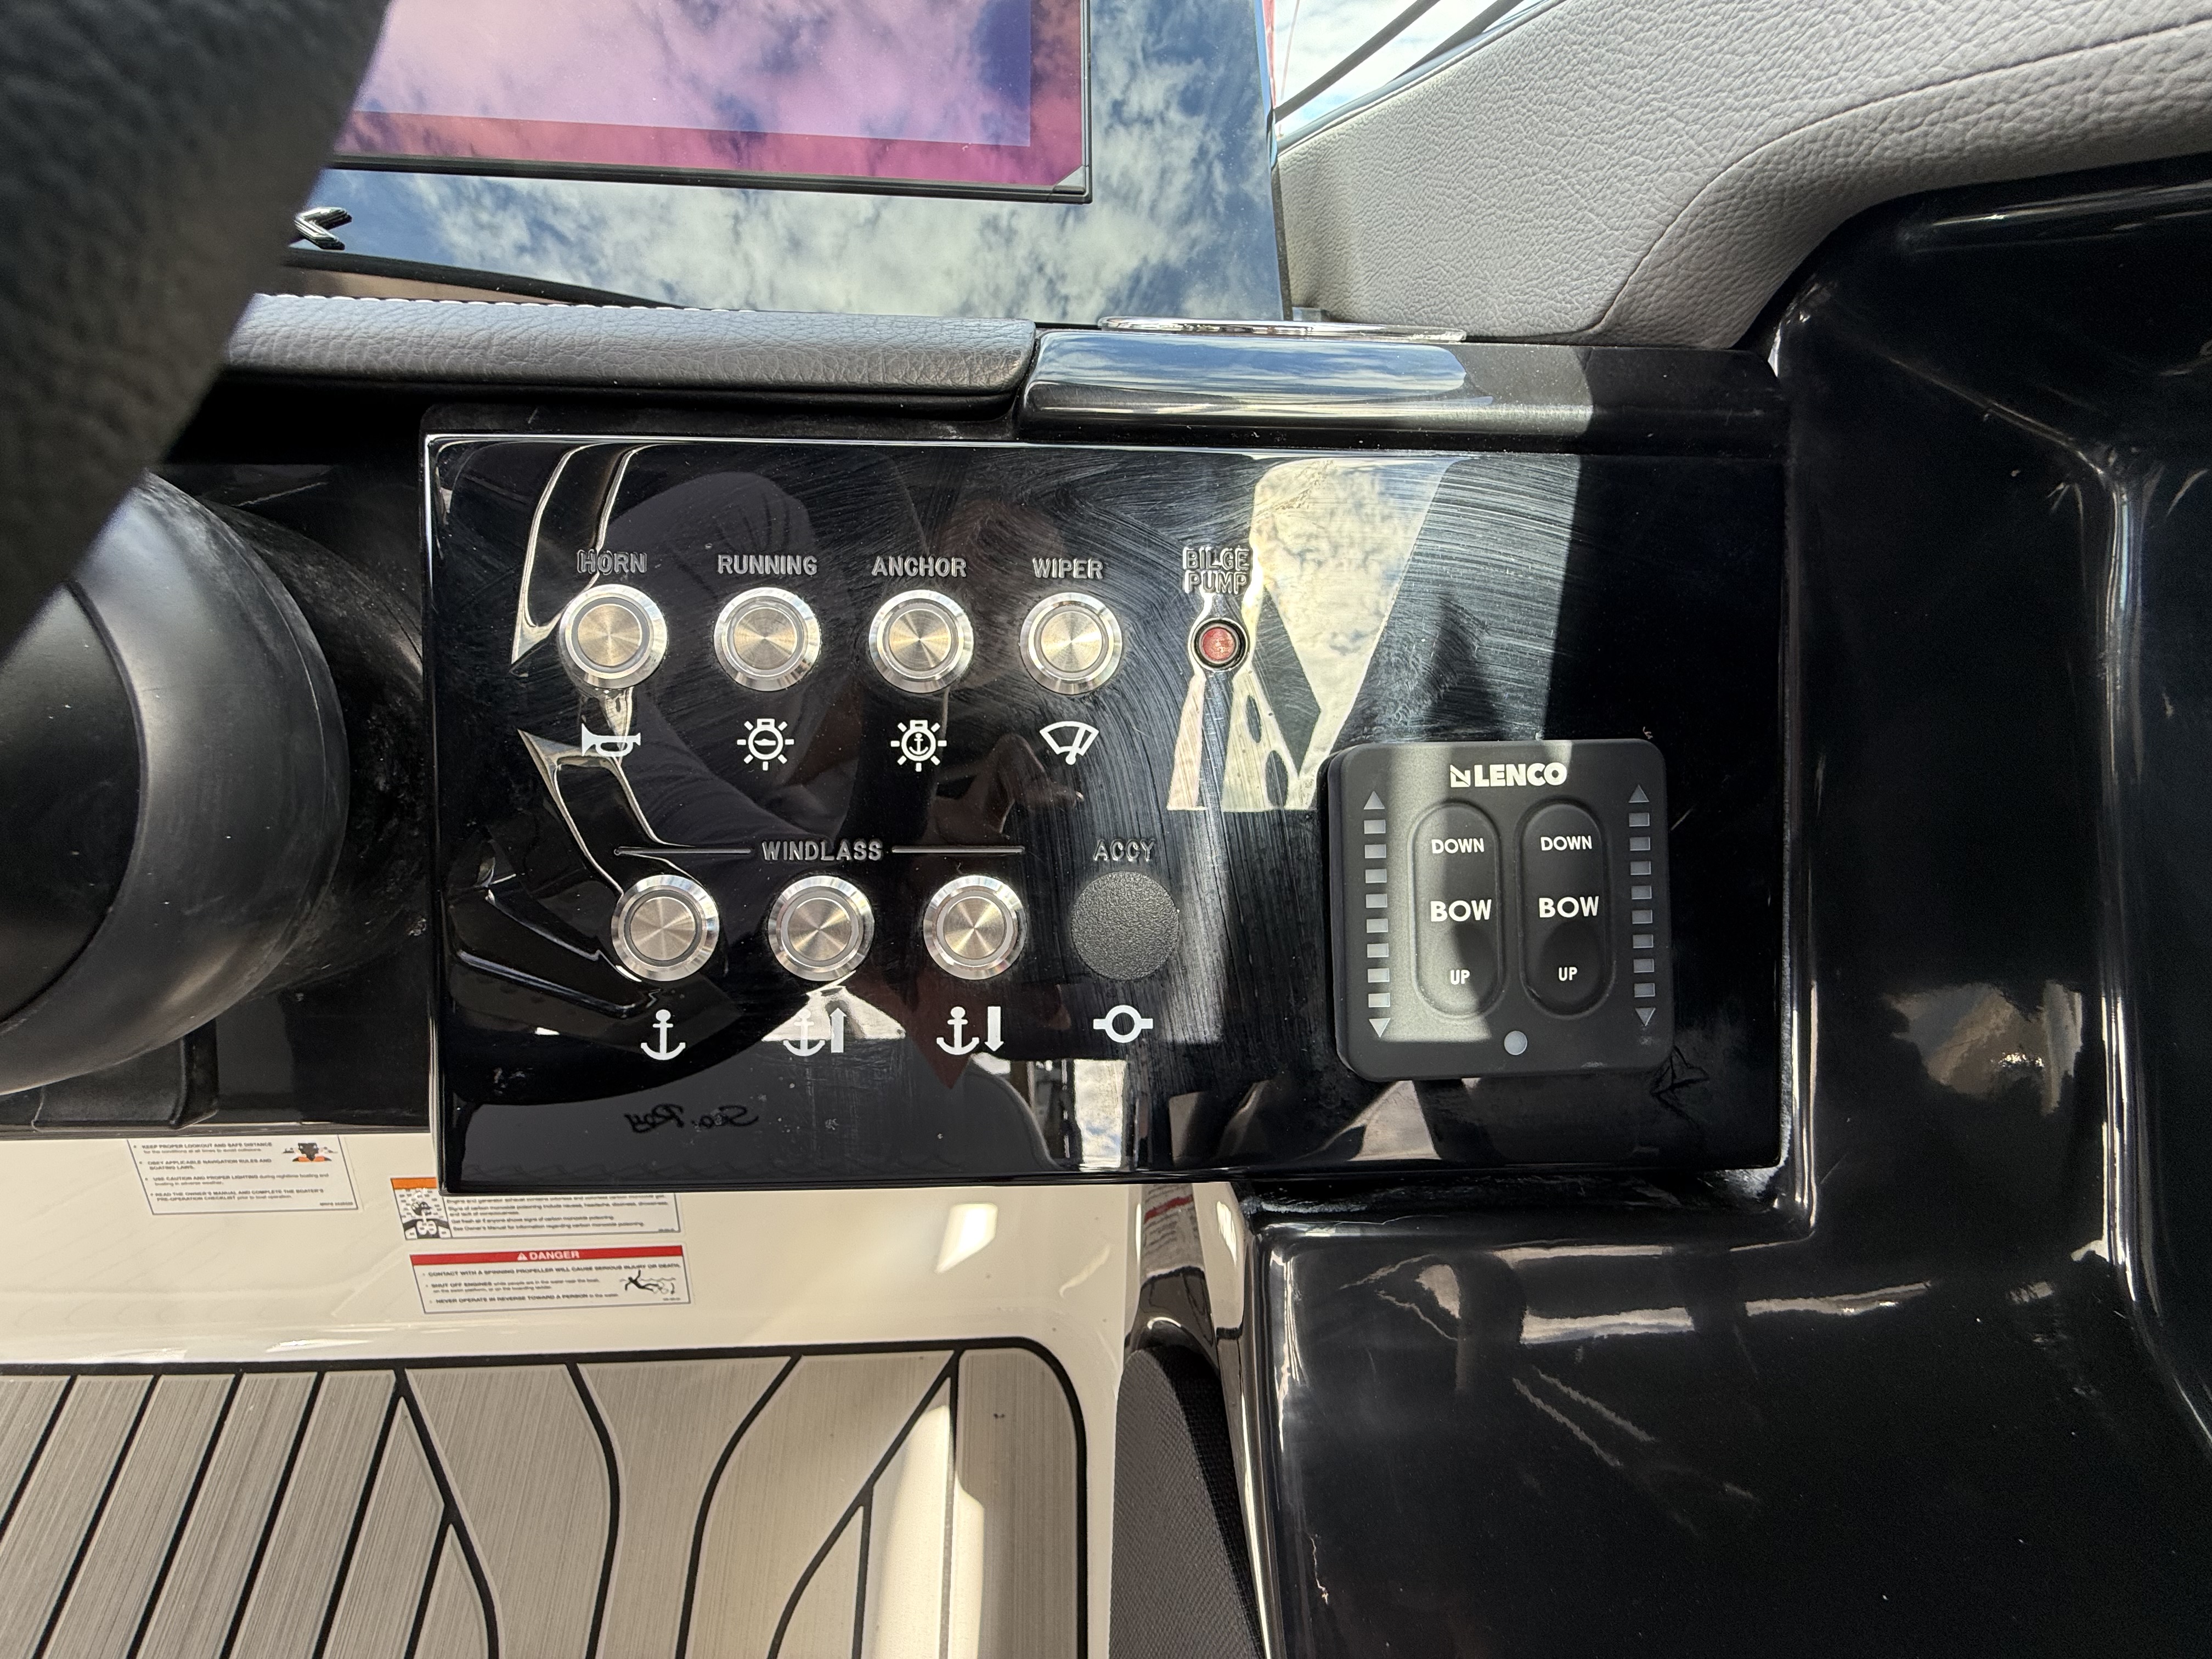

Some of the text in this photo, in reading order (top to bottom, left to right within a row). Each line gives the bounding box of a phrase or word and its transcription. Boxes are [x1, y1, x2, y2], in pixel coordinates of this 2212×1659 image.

[578, 550, 647, 574] HORN
[718, 555, 817, 575] RUNNING
[872, 556, 967, 577] ANCHOR
[1032, 558, 1103, 579] WIPER
[1183, 547, 1250, 571] BILGE
[1184, 571, 1248, 594] PUMP
[1474, 762, 1567, 787] LENCO
[761, 840, 882, 861] WINDLASS
[1093, 839, 1155, 861] ACCY
[1431, 838, 1485, 854] DOWN
[1541, 836, 1592, 851] DOWN
[1431, 899, 1492, 922] BOW
[1538, 896, 1599, 918] BOW
[1450, 969, 1470, 984] UP
[1558, 967, 1577, 981] UP
[529, 1251, 580, 1261] DANGER
